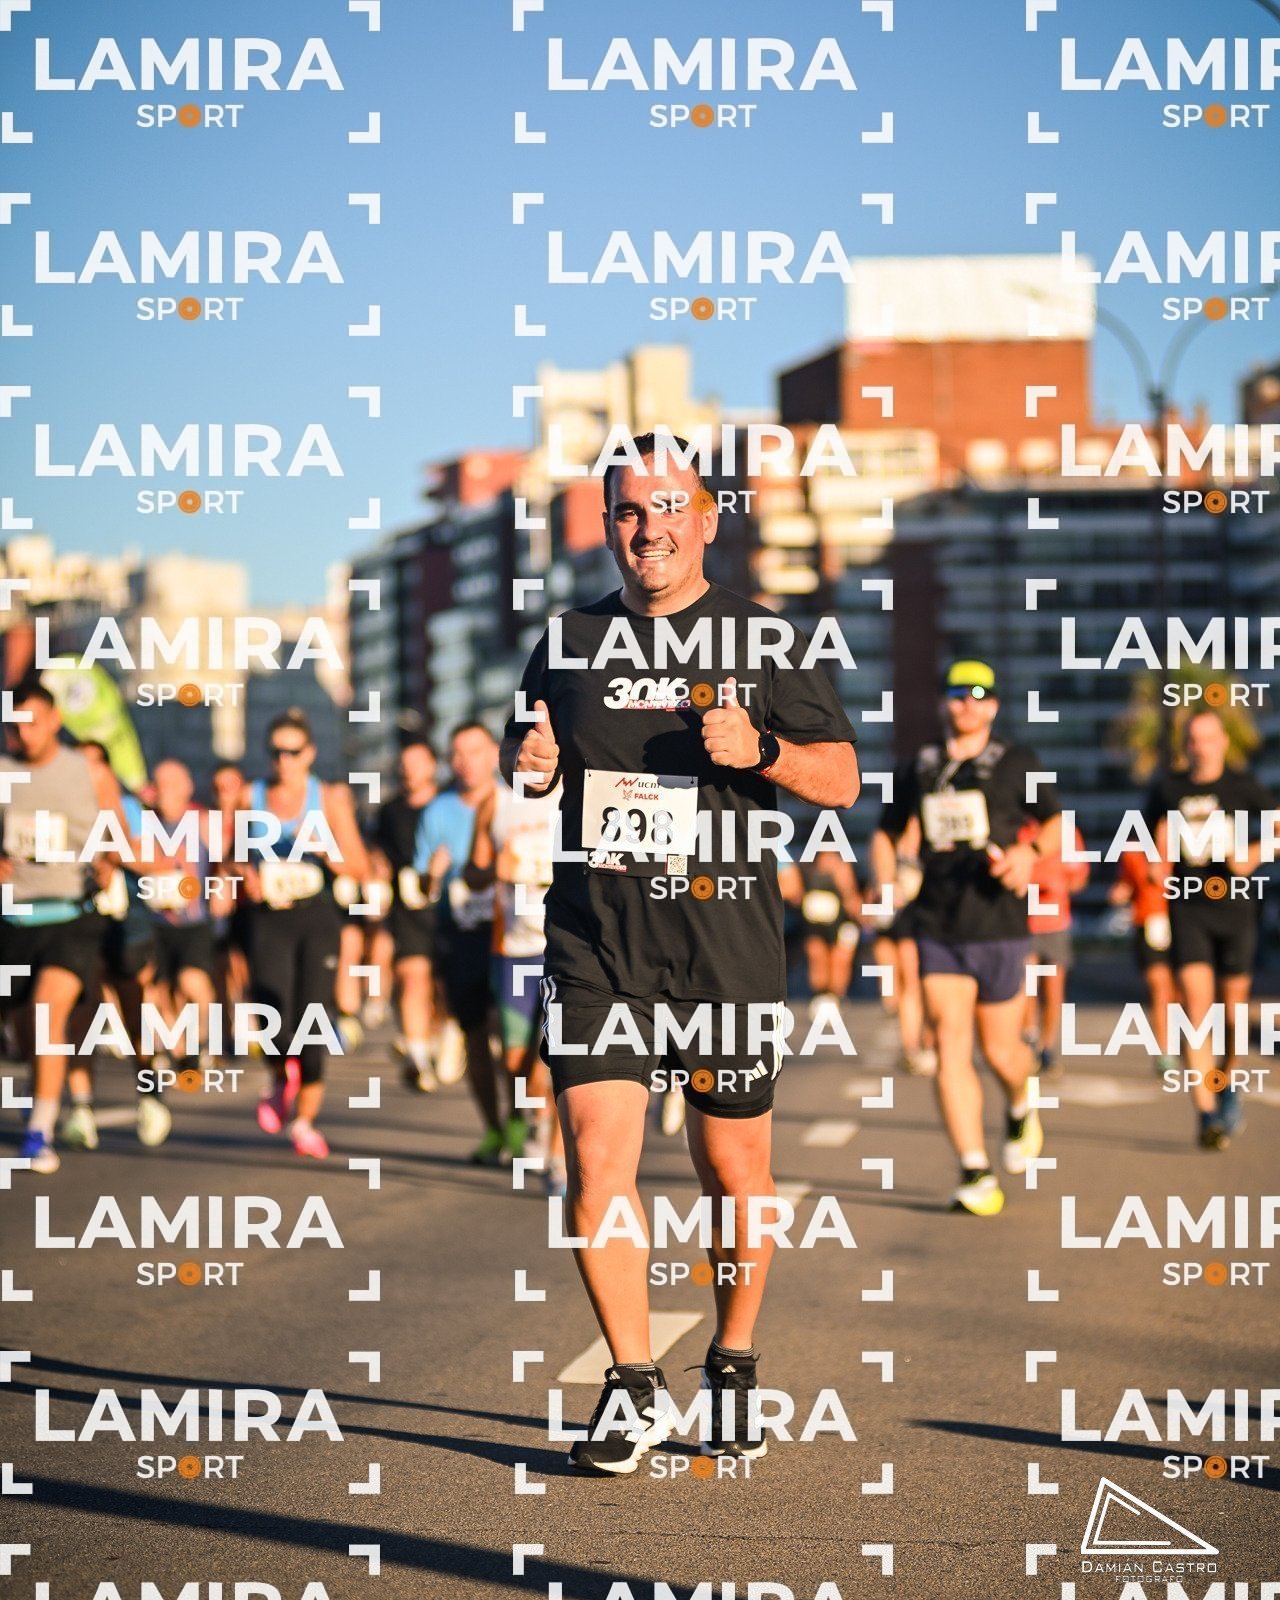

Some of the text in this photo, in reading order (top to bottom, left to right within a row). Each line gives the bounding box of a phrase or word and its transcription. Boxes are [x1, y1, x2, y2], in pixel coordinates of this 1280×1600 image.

[603, 677, 687, 709] 30K
[634, 792, 659, 801] FALCK
[601, 806, 674, 846] 898
